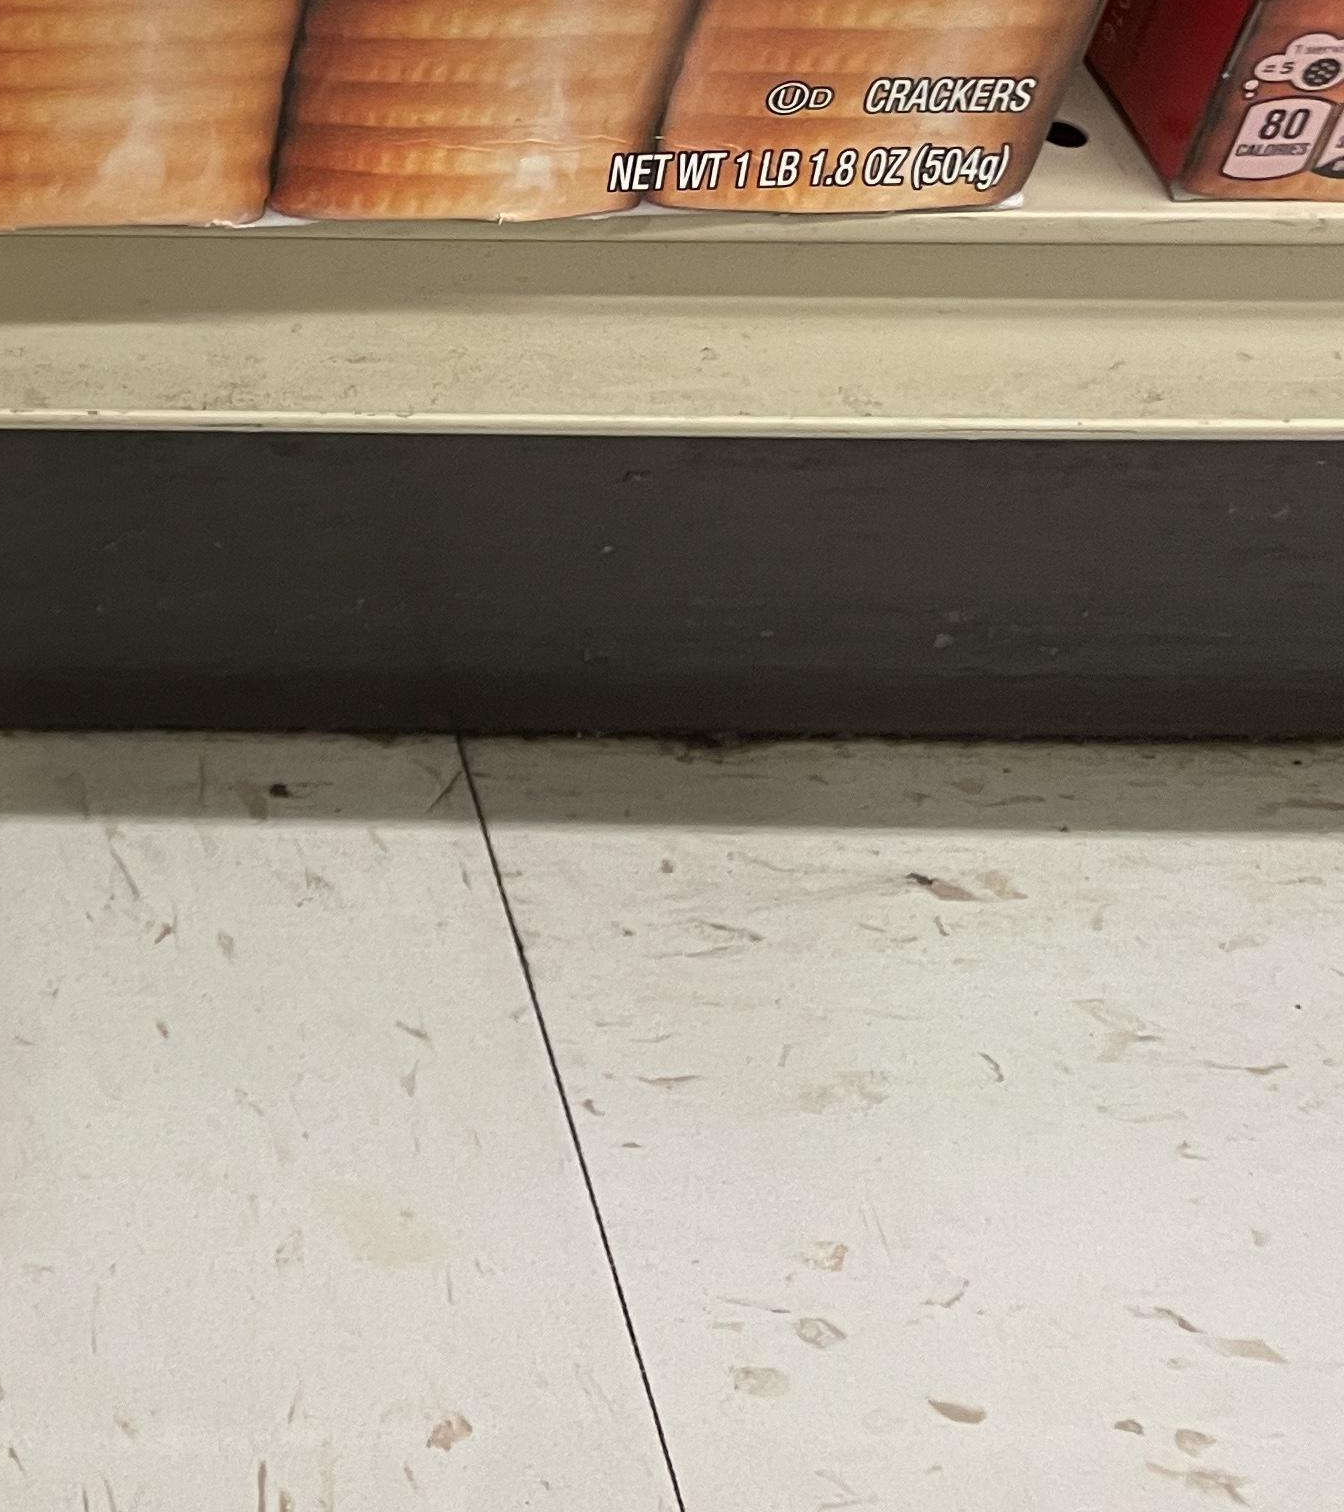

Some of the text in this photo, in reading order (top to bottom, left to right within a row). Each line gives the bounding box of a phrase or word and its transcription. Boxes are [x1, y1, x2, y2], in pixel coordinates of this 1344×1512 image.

[864, 76, 1036, 115] CRACKERS
[1259, 108, 1311, 140] 80
[607, 141, 1012, 194] NET WT LB 1.8 OZ (504g)
